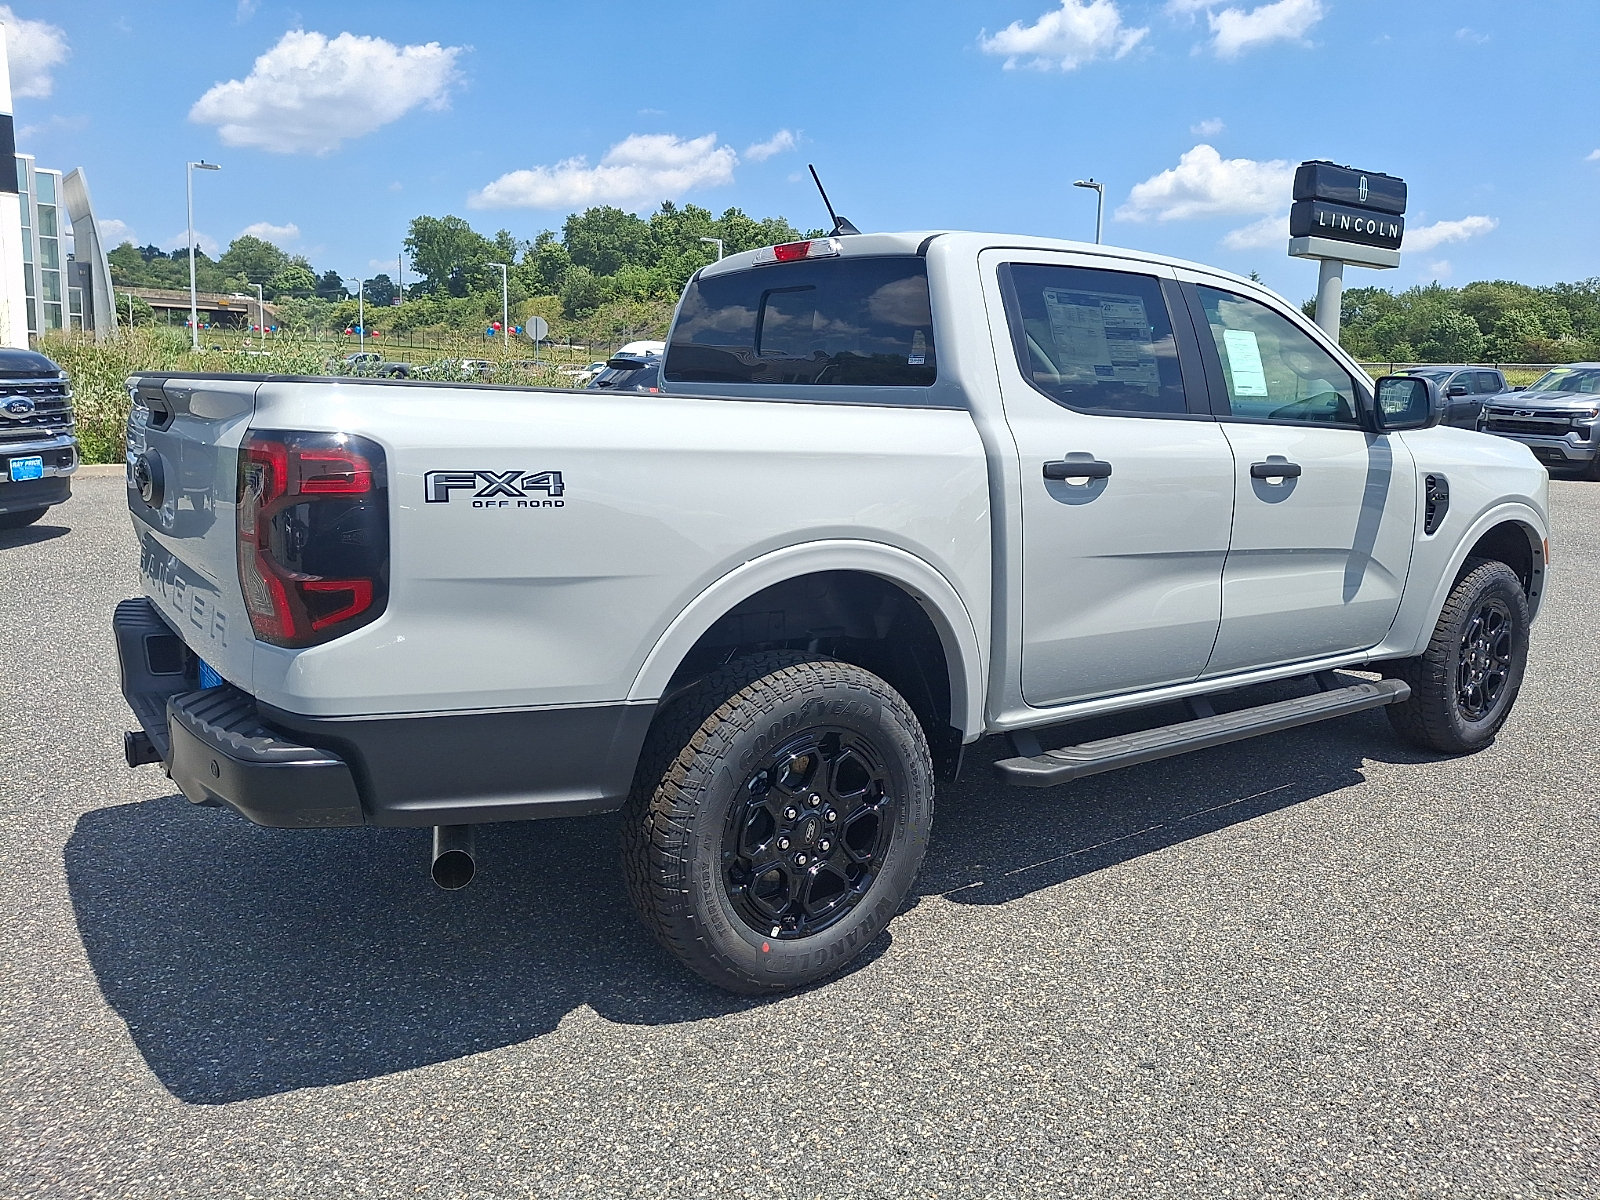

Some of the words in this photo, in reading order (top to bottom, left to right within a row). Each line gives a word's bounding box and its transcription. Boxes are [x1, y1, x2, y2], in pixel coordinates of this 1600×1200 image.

[1319, 211, 1398, 238] LINCOLN
[424, 470, 565, 503] FX4
[472, 500, 509, 508] OFF
[517, 500, 565, 508] ROAD
[739, 697, 873, 770] GOODYEAR
